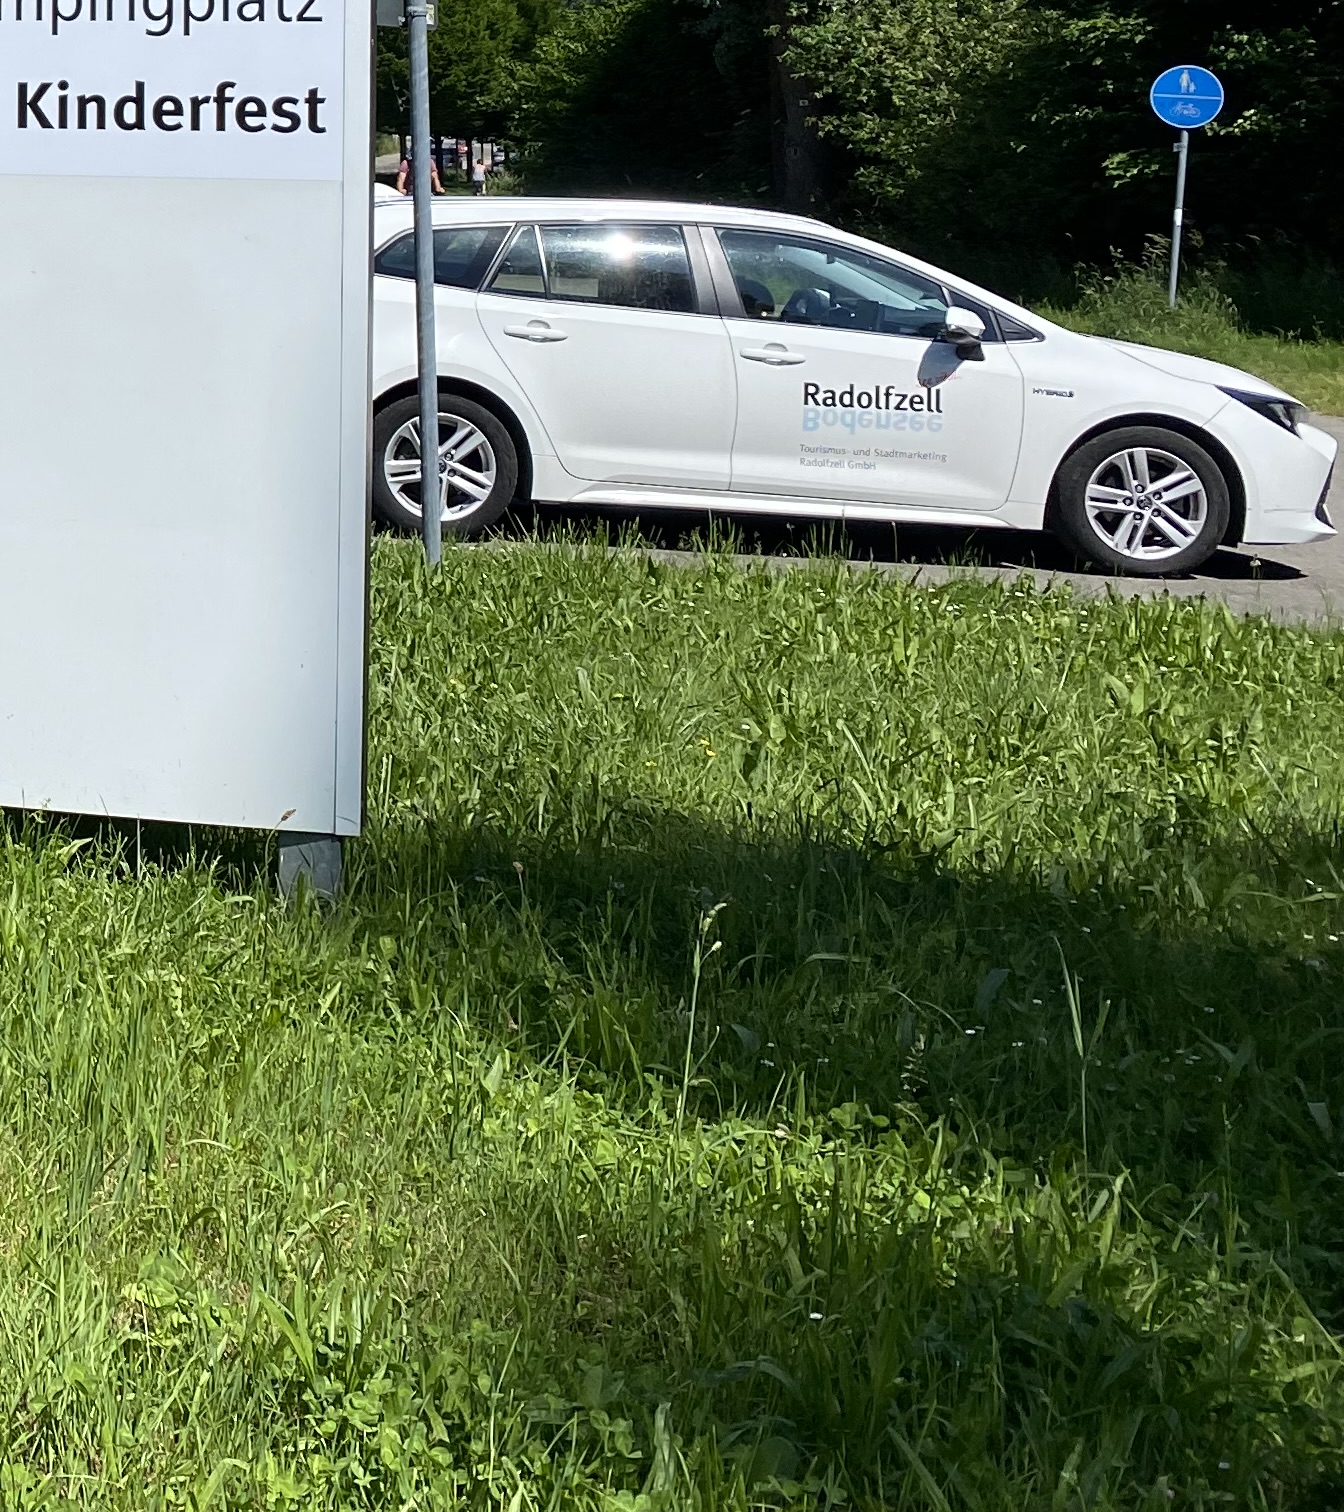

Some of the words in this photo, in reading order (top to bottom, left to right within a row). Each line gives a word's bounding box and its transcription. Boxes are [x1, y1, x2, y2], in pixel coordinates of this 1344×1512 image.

[17, 79, 327, 136] Kinderfest
[802, 381, 944, 414] Radolfzell
[799, 457, 846, 470] Radolfzell
[848, 459, 877, 471] GmbH
[853, 447, 871, 457] und
[874, 447, 948, 463] Stadtmarketing
